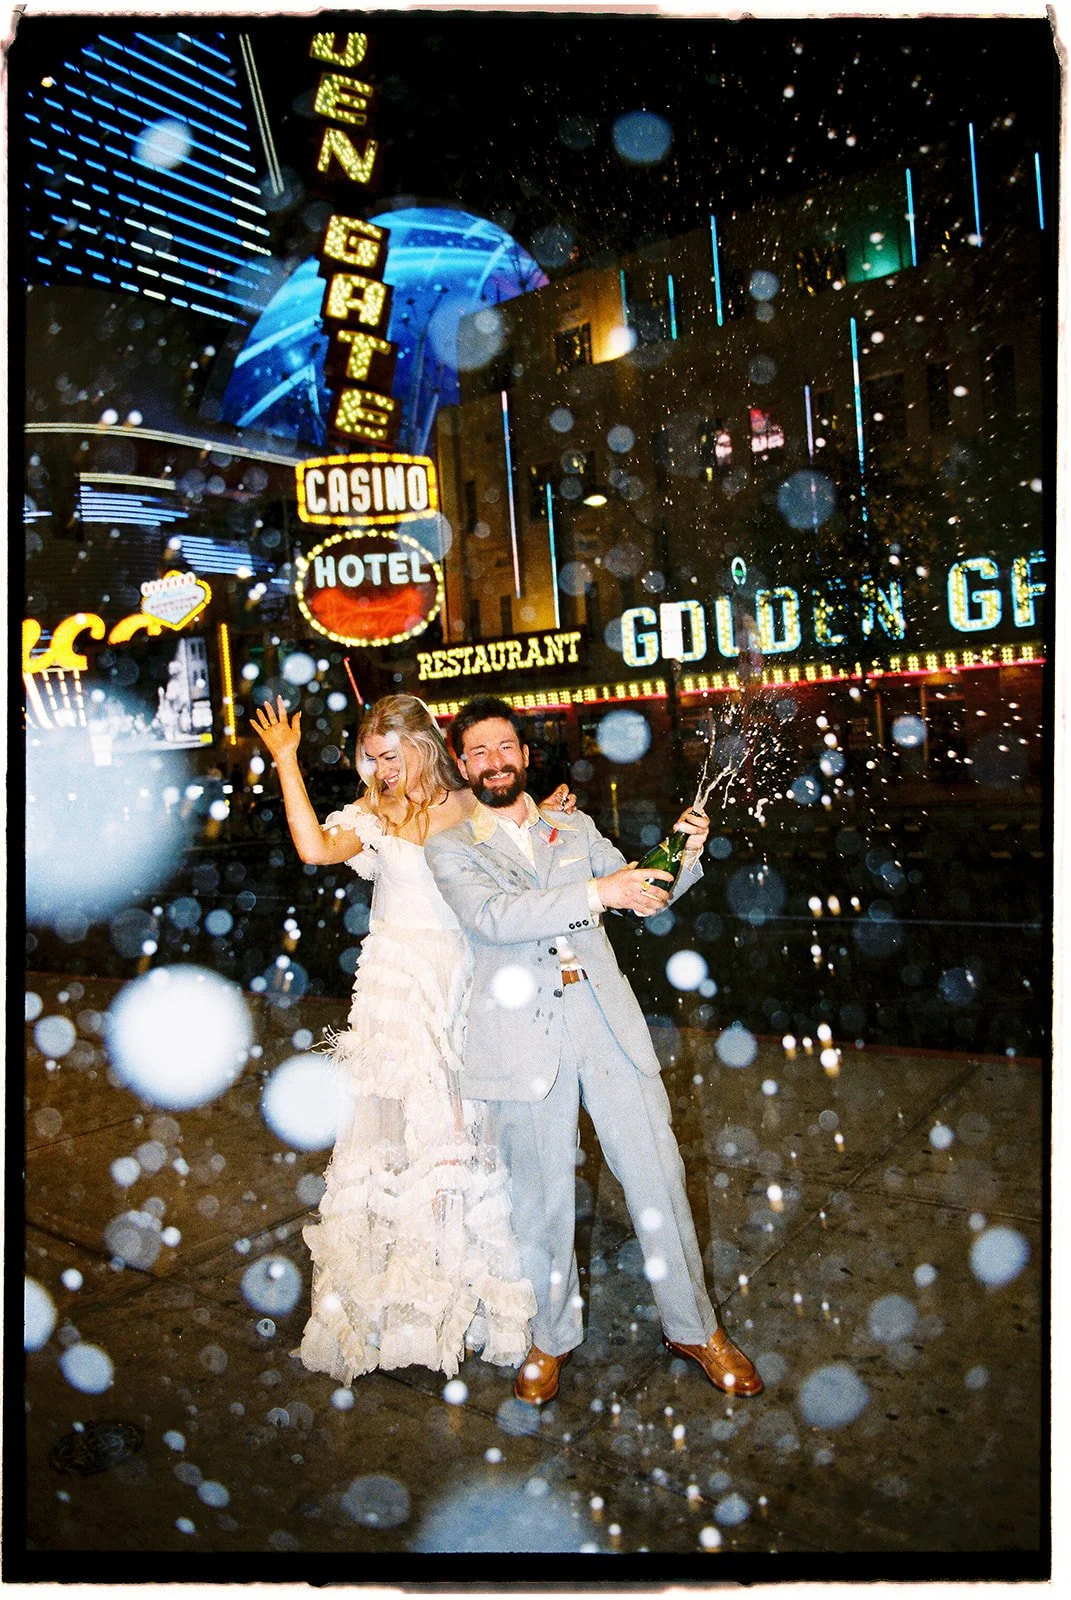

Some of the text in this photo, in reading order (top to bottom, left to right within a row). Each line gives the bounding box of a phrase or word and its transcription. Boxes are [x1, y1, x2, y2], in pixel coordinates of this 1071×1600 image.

[323, 214, 394, 441] GATE
[305, 464, 429, 514] CASINO
[313, 551, 431, 589] HOTEL
[417, 631, 582, 681] RESTAURANT
